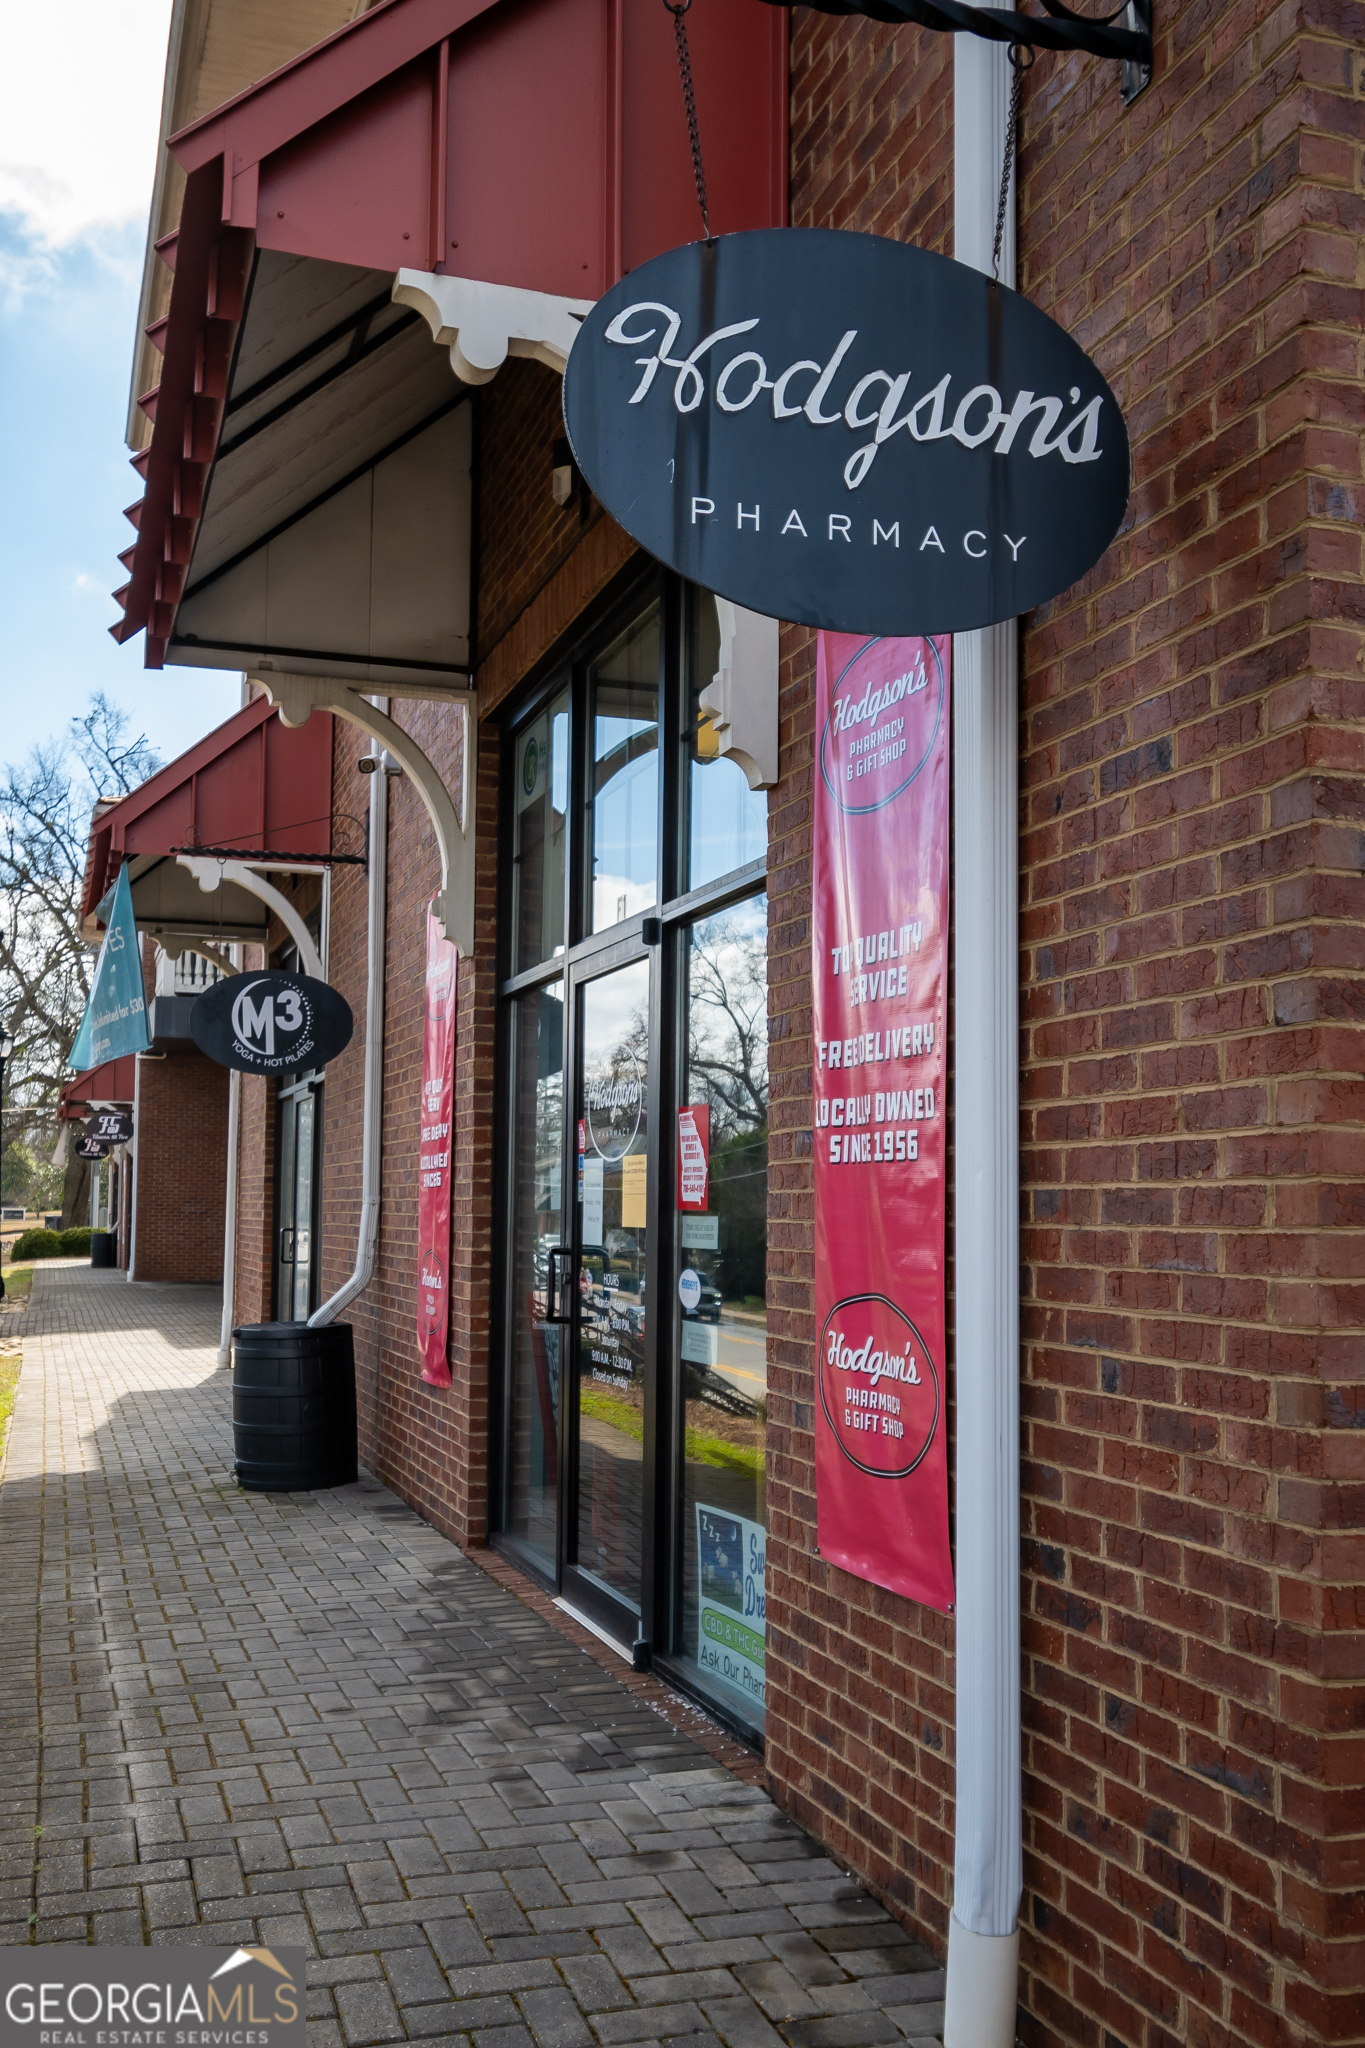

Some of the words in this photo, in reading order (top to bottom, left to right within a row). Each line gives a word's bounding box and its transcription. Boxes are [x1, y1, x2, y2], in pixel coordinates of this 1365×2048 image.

[604, 302, 1104, 490] Hodgson's
[691, 497, 1027, 562] PHARMACY
[833, 650, 929, 737] Hodgson's
[849, 716, 905, 759] PHARMACY
[846, 764, 854, 781] &
[856, 753, 878, 777] GIFT
[880, 738, 907, 766] SHOP
[855, 920, 922, 973] QUALITY
[130, 996, 144, 1016] $30
[850, 965, 908, 1009] SERVICE
[242, 990, 303, 1055] M3
[231, 1039, 254, 1062] YOGA
[264, 1058, 283, 1067] HOT
[285, 1039, 315, 1065] PILATES
[818, 1037, 859, 1069] FREE
[859, 1022, 935, 1064] DELIVERY
[815, 1094, 871, 1128] LOCALLY
[875, 1087, 935, 1123] OWNED
[598, 1128, 630, 1139] PHARMACY
[829, 1132, 872, 1164] SINCE
[874, 1129, 918, 1162] 1956
[603, 1273, 619, 1287] HOURS
[827, 1330, 922, 1386] Hodgson's
[612, 1373, 629, 1392] Sunday
[846, 1387, 901, 1416] PHARMACY
[845, 1409, 851, 1427] &
[853, 1411, 880, 1433] GIFT
[882, 1417, 905, 1441] SHOP
[704, 1614, 723, 1636] CBD
[725, 1623, 732, 1641] &
[733, 1627, 750, 1652] THC
[701, 1644, 720, 1670] Ask
[723, 1655, 740, 1680] Our
